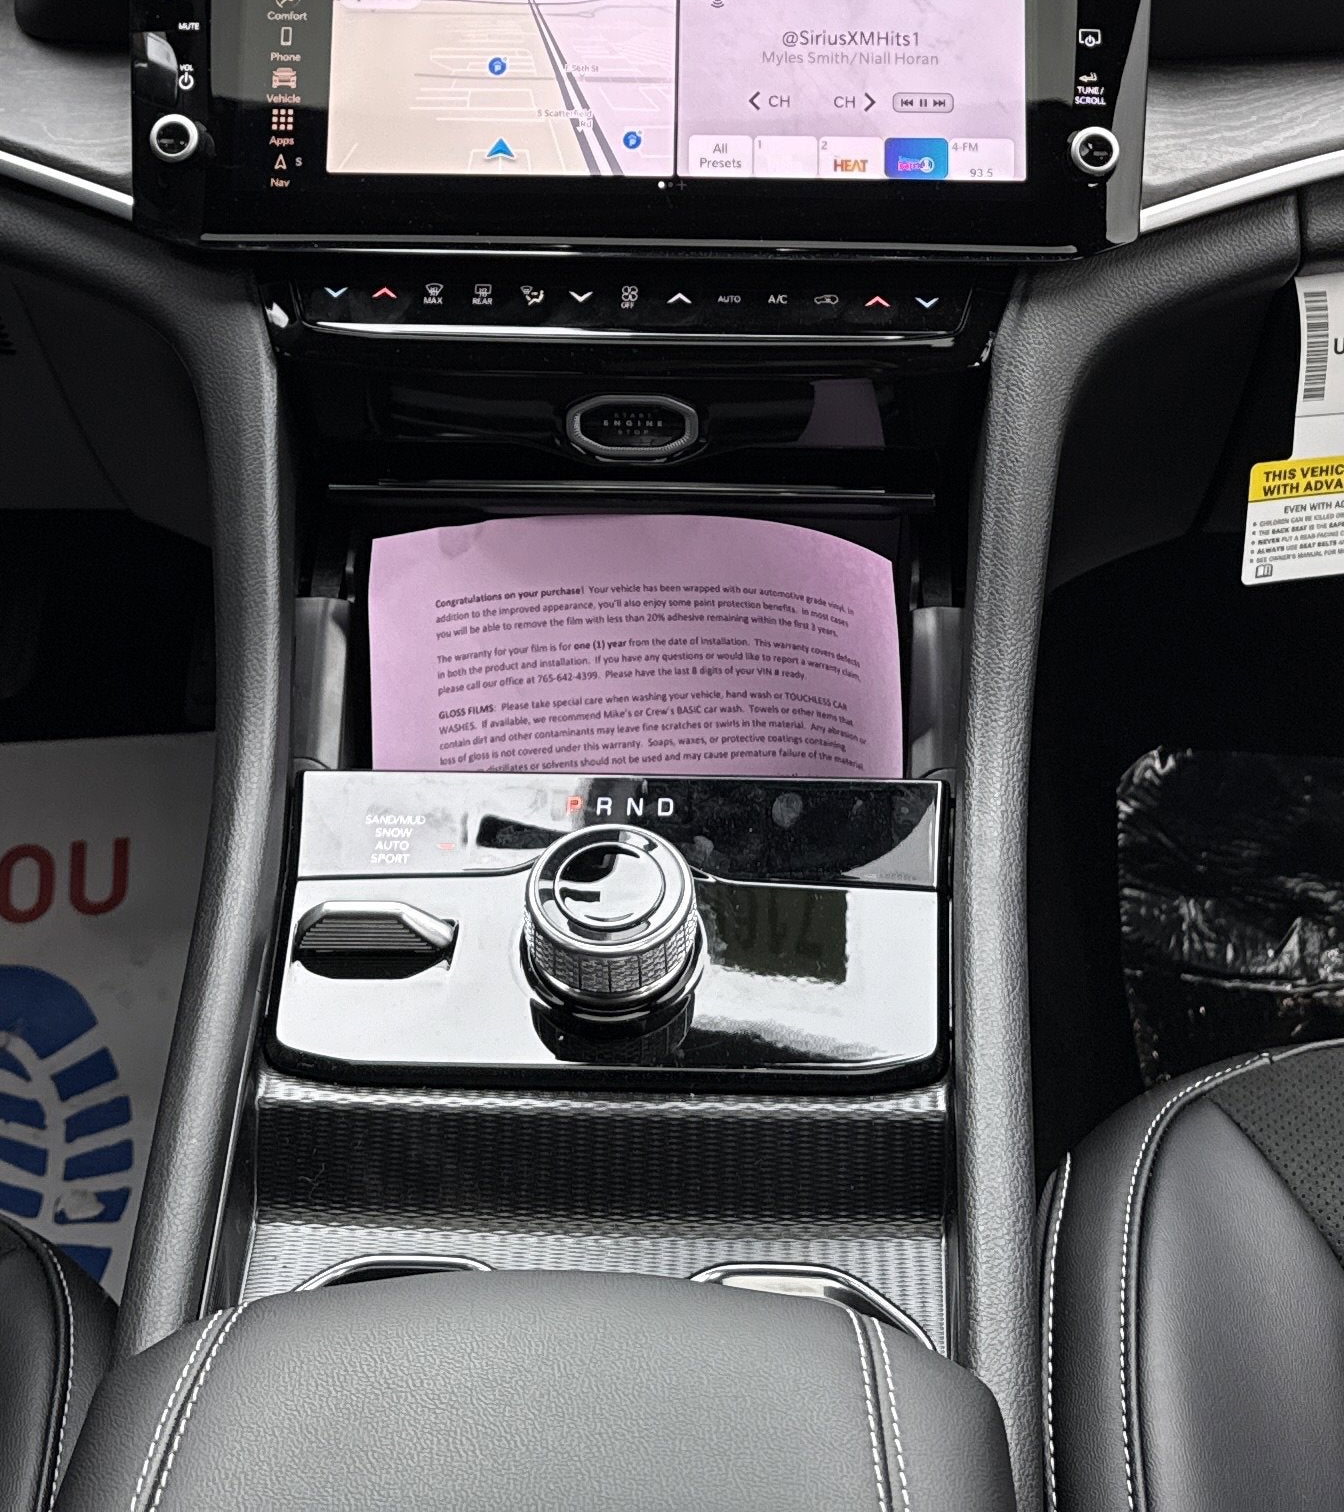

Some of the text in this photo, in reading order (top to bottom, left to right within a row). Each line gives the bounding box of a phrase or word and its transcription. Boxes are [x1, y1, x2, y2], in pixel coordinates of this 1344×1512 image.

[268, 11, 307, 21] Comfort
[178, 22, 199, 30] MUTE
[782, 30, 919, 47] @SiriusXMHits1
[270, 52, 300, 62] Phone
[762, 51, 938, 66] Myles Smith/Niall Horan
[267, 94, 301, 103] Vehicle
[769, 96, 790, 108] CH
[834, 96, 855, 108] CH
[1075, 96, 1106, 105] SCROLL
[269, 136, 294, 147] Apps
[821, 141, 827, 150] 2
[713, 143, 728, 154] All
[699, 156, 742, 170] Presets
[834, 159, 868, 172] HEAT
[270, 178, 290, 187] Nav
[472, 297, 492, 305] REAR
[718, 295, 741, 303] AUTO
[768, 294, 788, 304] A/C
[1263, 468, 1296, 482] THIS
[1262, 482, 1300, 497] WITH
[1284, 504, 1306, 514] EVEN
[1309, 502, 1332, 511] WITH
[434, 593, 502, 608] Congratulations
[517, 591, 538, 601] your
[540, 586, 584, 599] purchase!
[588, 586, 608, 594] Your
[610, 584, 640, 594] vehicle
[642, 584, 657, 593] has
[659, 584, 680, 592] been
[682, 584, 720, 595] wrapped
[722, 585, 740, 594] with
[742, 587, 756, 595] our
[759, 588, 804, 601] automotive
[805, 596, 826, 607] grade
[437, 684, 464, 697] please
[466, 679, 480, 690] call
[482, 679, 497, 687] our
[499, 675, 524, 685] office
[526, 674, 535, 683] at
[604, 669, 632, 678] Please
[634, 667, 655, 676] have
[438, 707, 466, 720] GLOSS
[467, 704, 496, 715] FILMS:
[501, 701, 528, 711] Please
[531, 698, 550, 708] take
[552, 696, 582, 709] special
[605, 694, 629, 703] when
[631, 692, 667, 703] washing
[668, 693, 688, 702] your
[725, 690, 747, 698] hand
[749, 690, 771, 699] wash
[784, 691, 831, 706] TOUCHLESS
[566, 796, 674, 816] P R N D
[366, 815, 426, 825] SAND/MUD
[375, 828, 412, 838] SNOW
[375, 841, 409, 851] AUTO
[370, 854, 409, 864] SPORT
